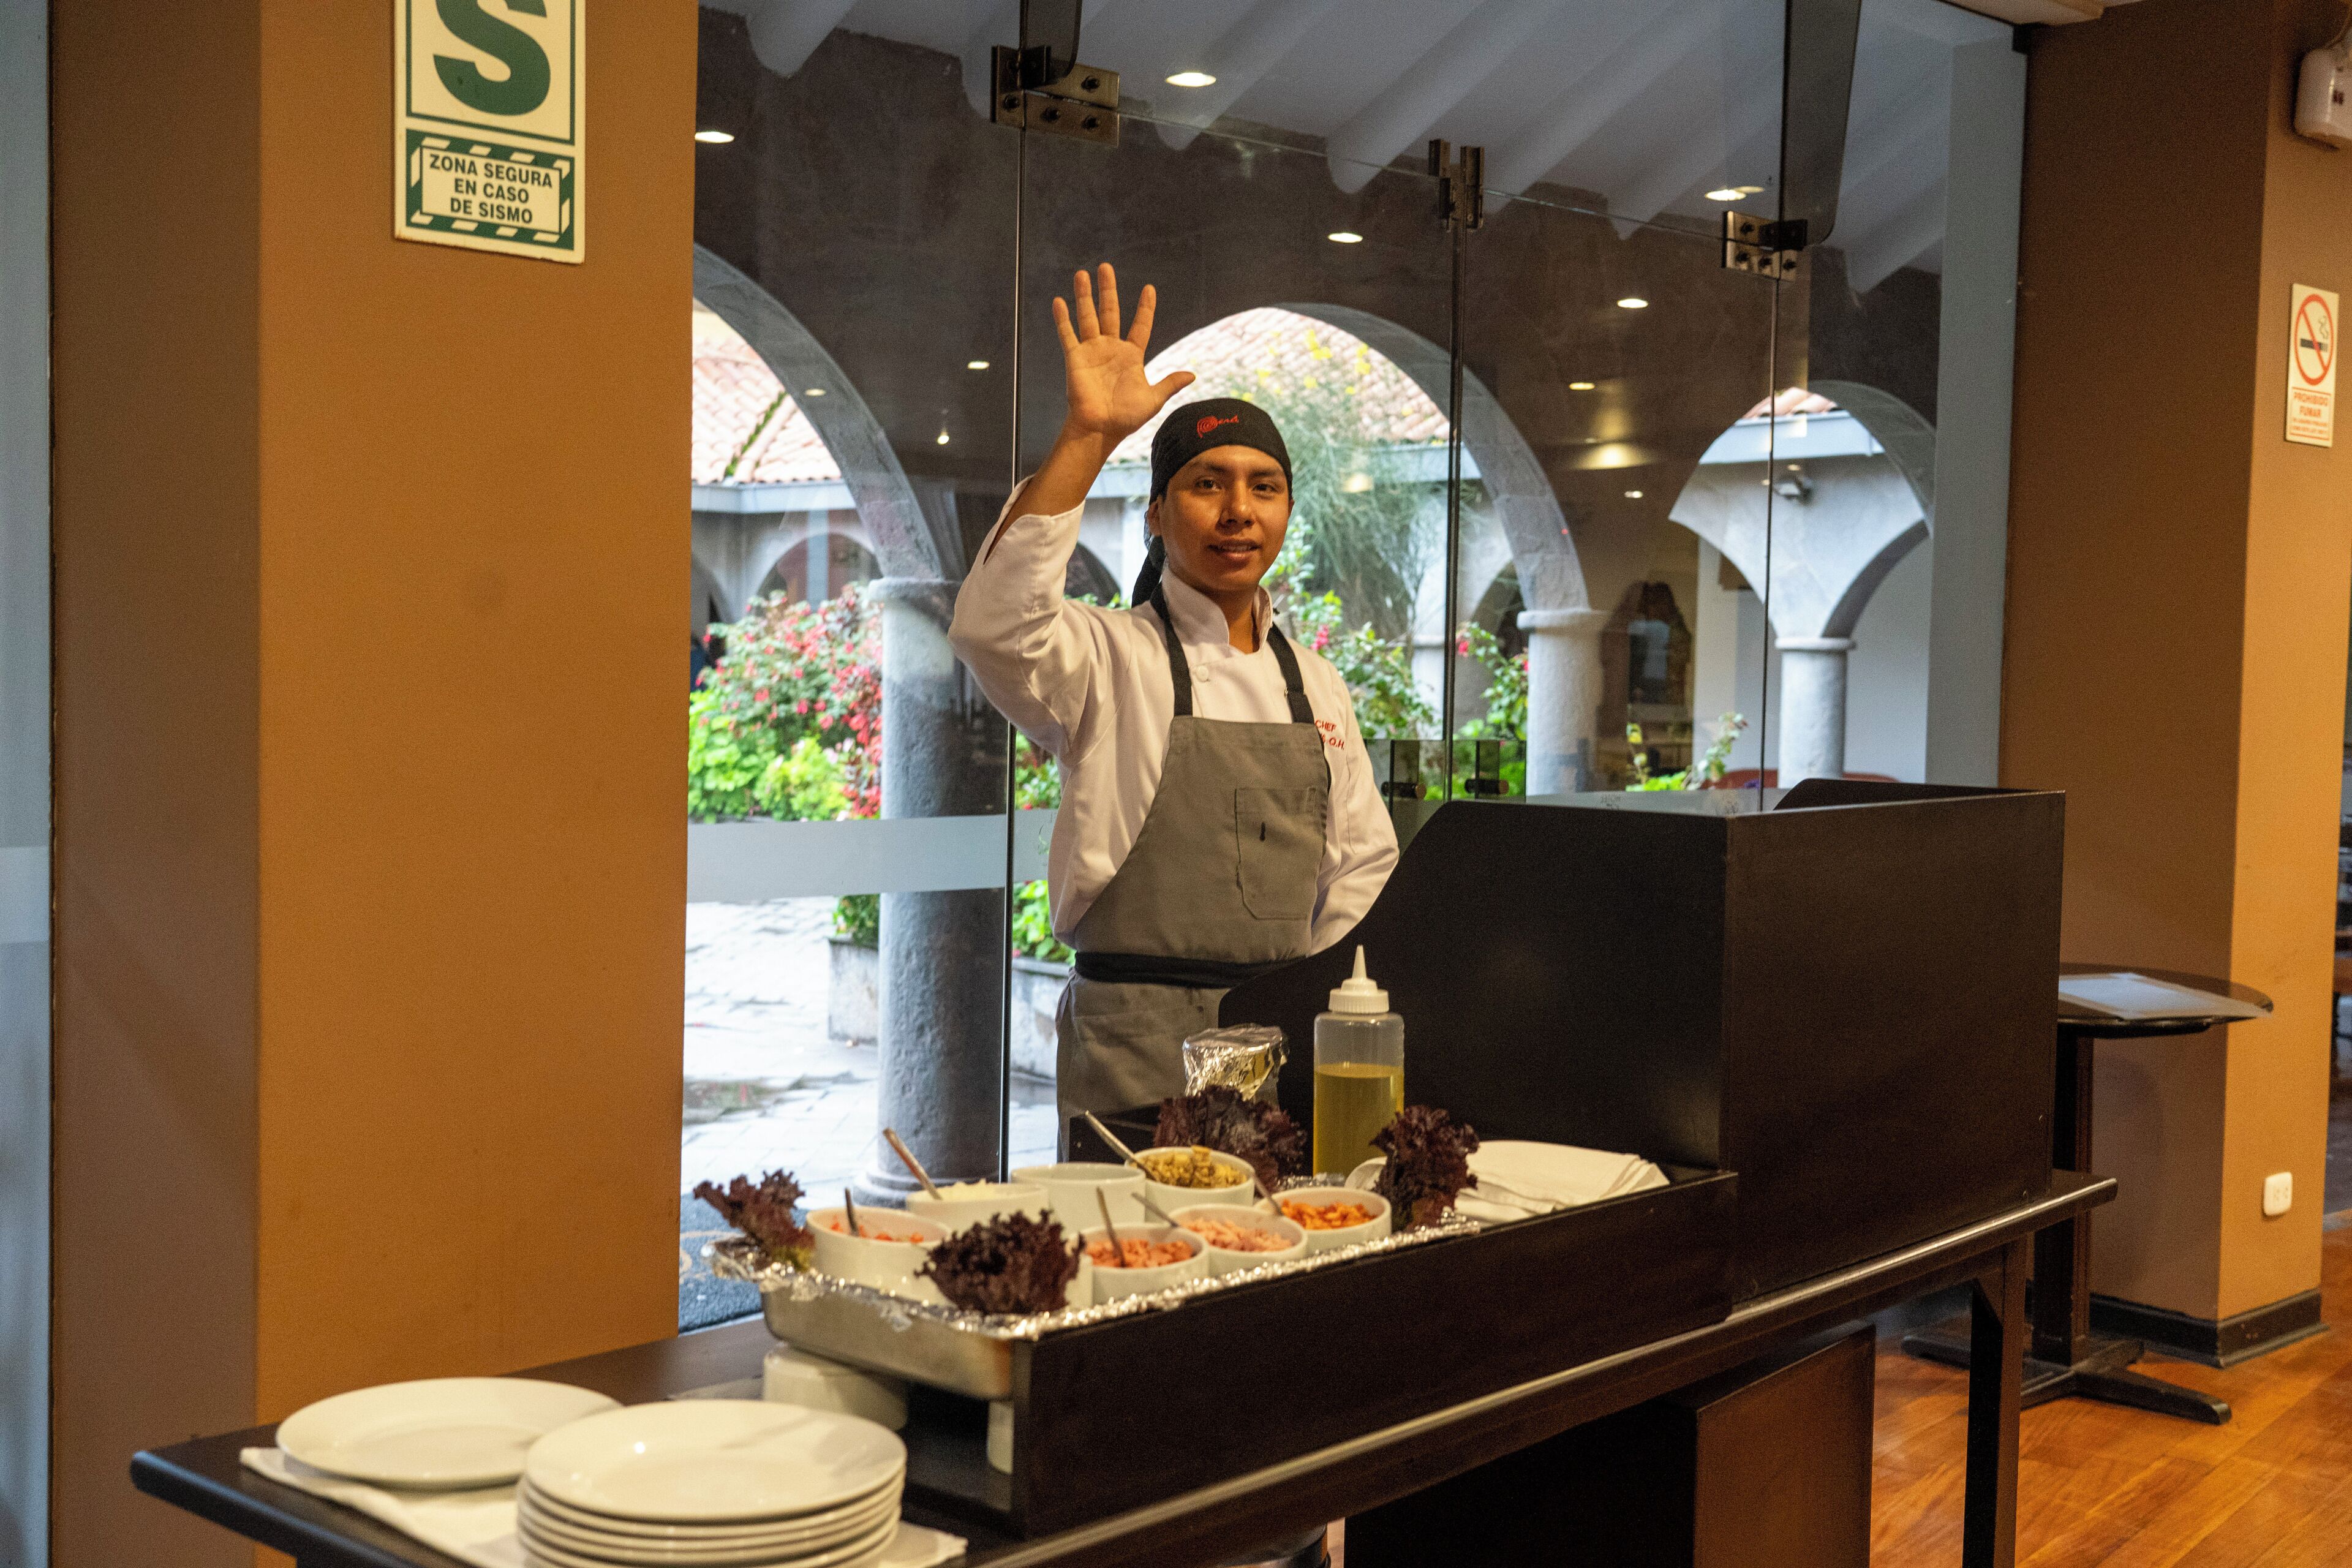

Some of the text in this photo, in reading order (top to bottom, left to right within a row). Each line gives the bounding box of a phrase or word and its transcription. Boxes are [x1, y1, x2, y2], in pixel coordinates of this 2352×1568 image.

[433, 0, 551, 116] S
[430, 154, 552, 188] ZONA SEGURA
[454, 178, 529, 203] EN CASO
[451, 197, 533, 224] DE SISMO
[1315, 720, 1336, 733] CHEF
